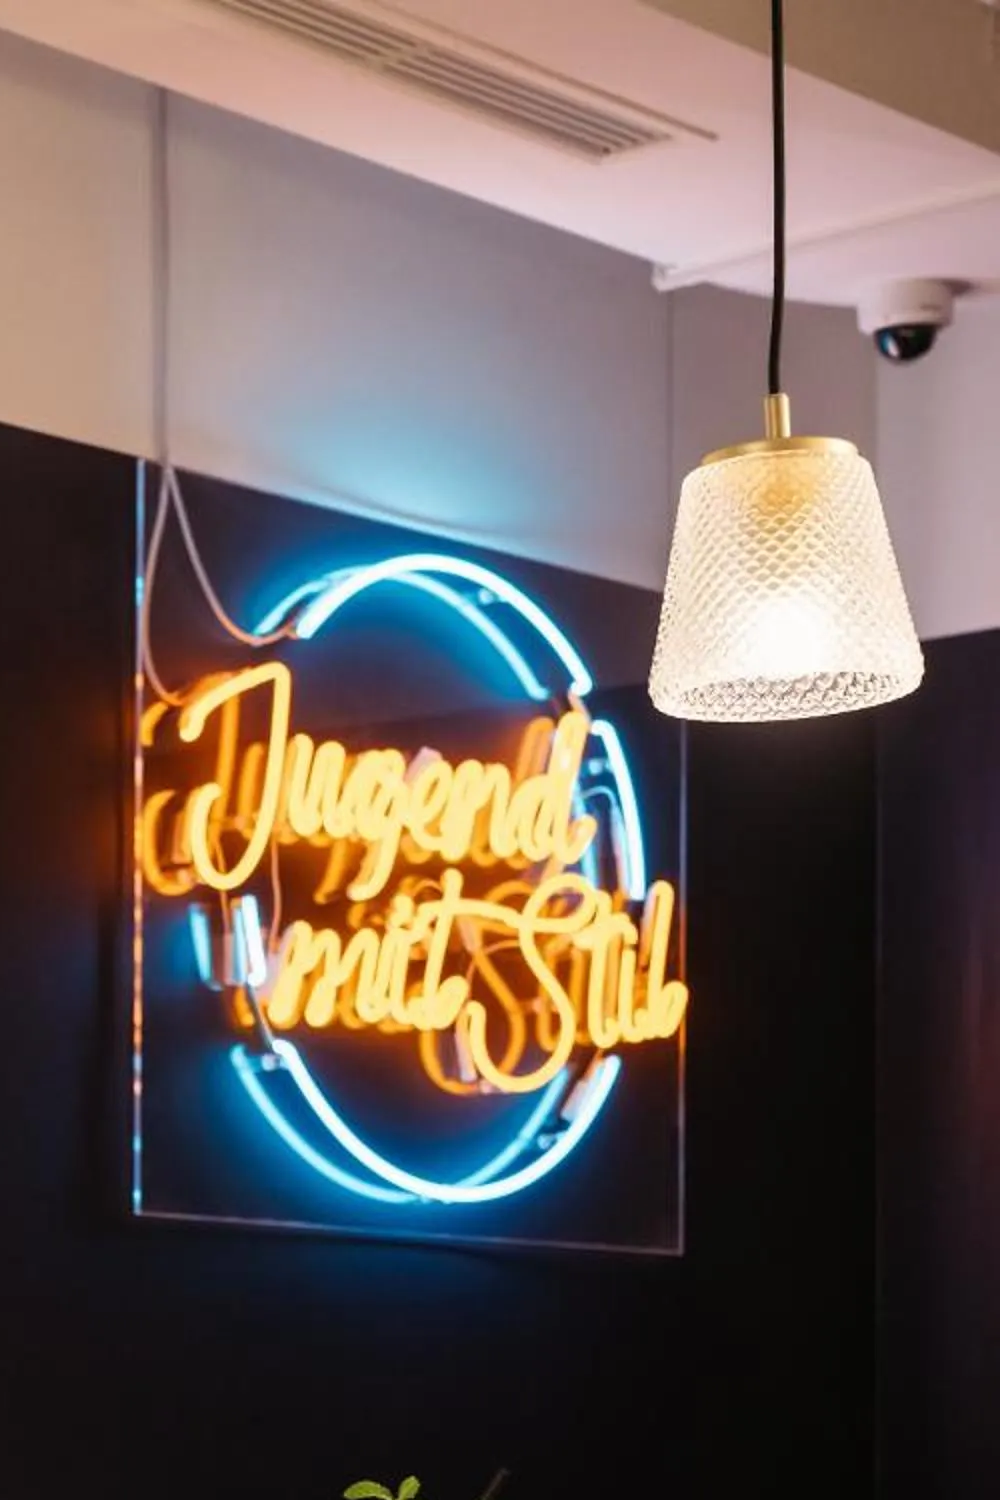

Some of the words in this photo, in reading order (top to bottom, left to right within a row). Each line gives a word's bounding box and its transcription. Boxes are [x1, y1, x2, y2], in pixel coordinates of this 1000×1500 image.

[179, 661, 597, 901] Jugend
[266, 867, 472, 1030] mit
[463, 872, 690, 1094] Stil
